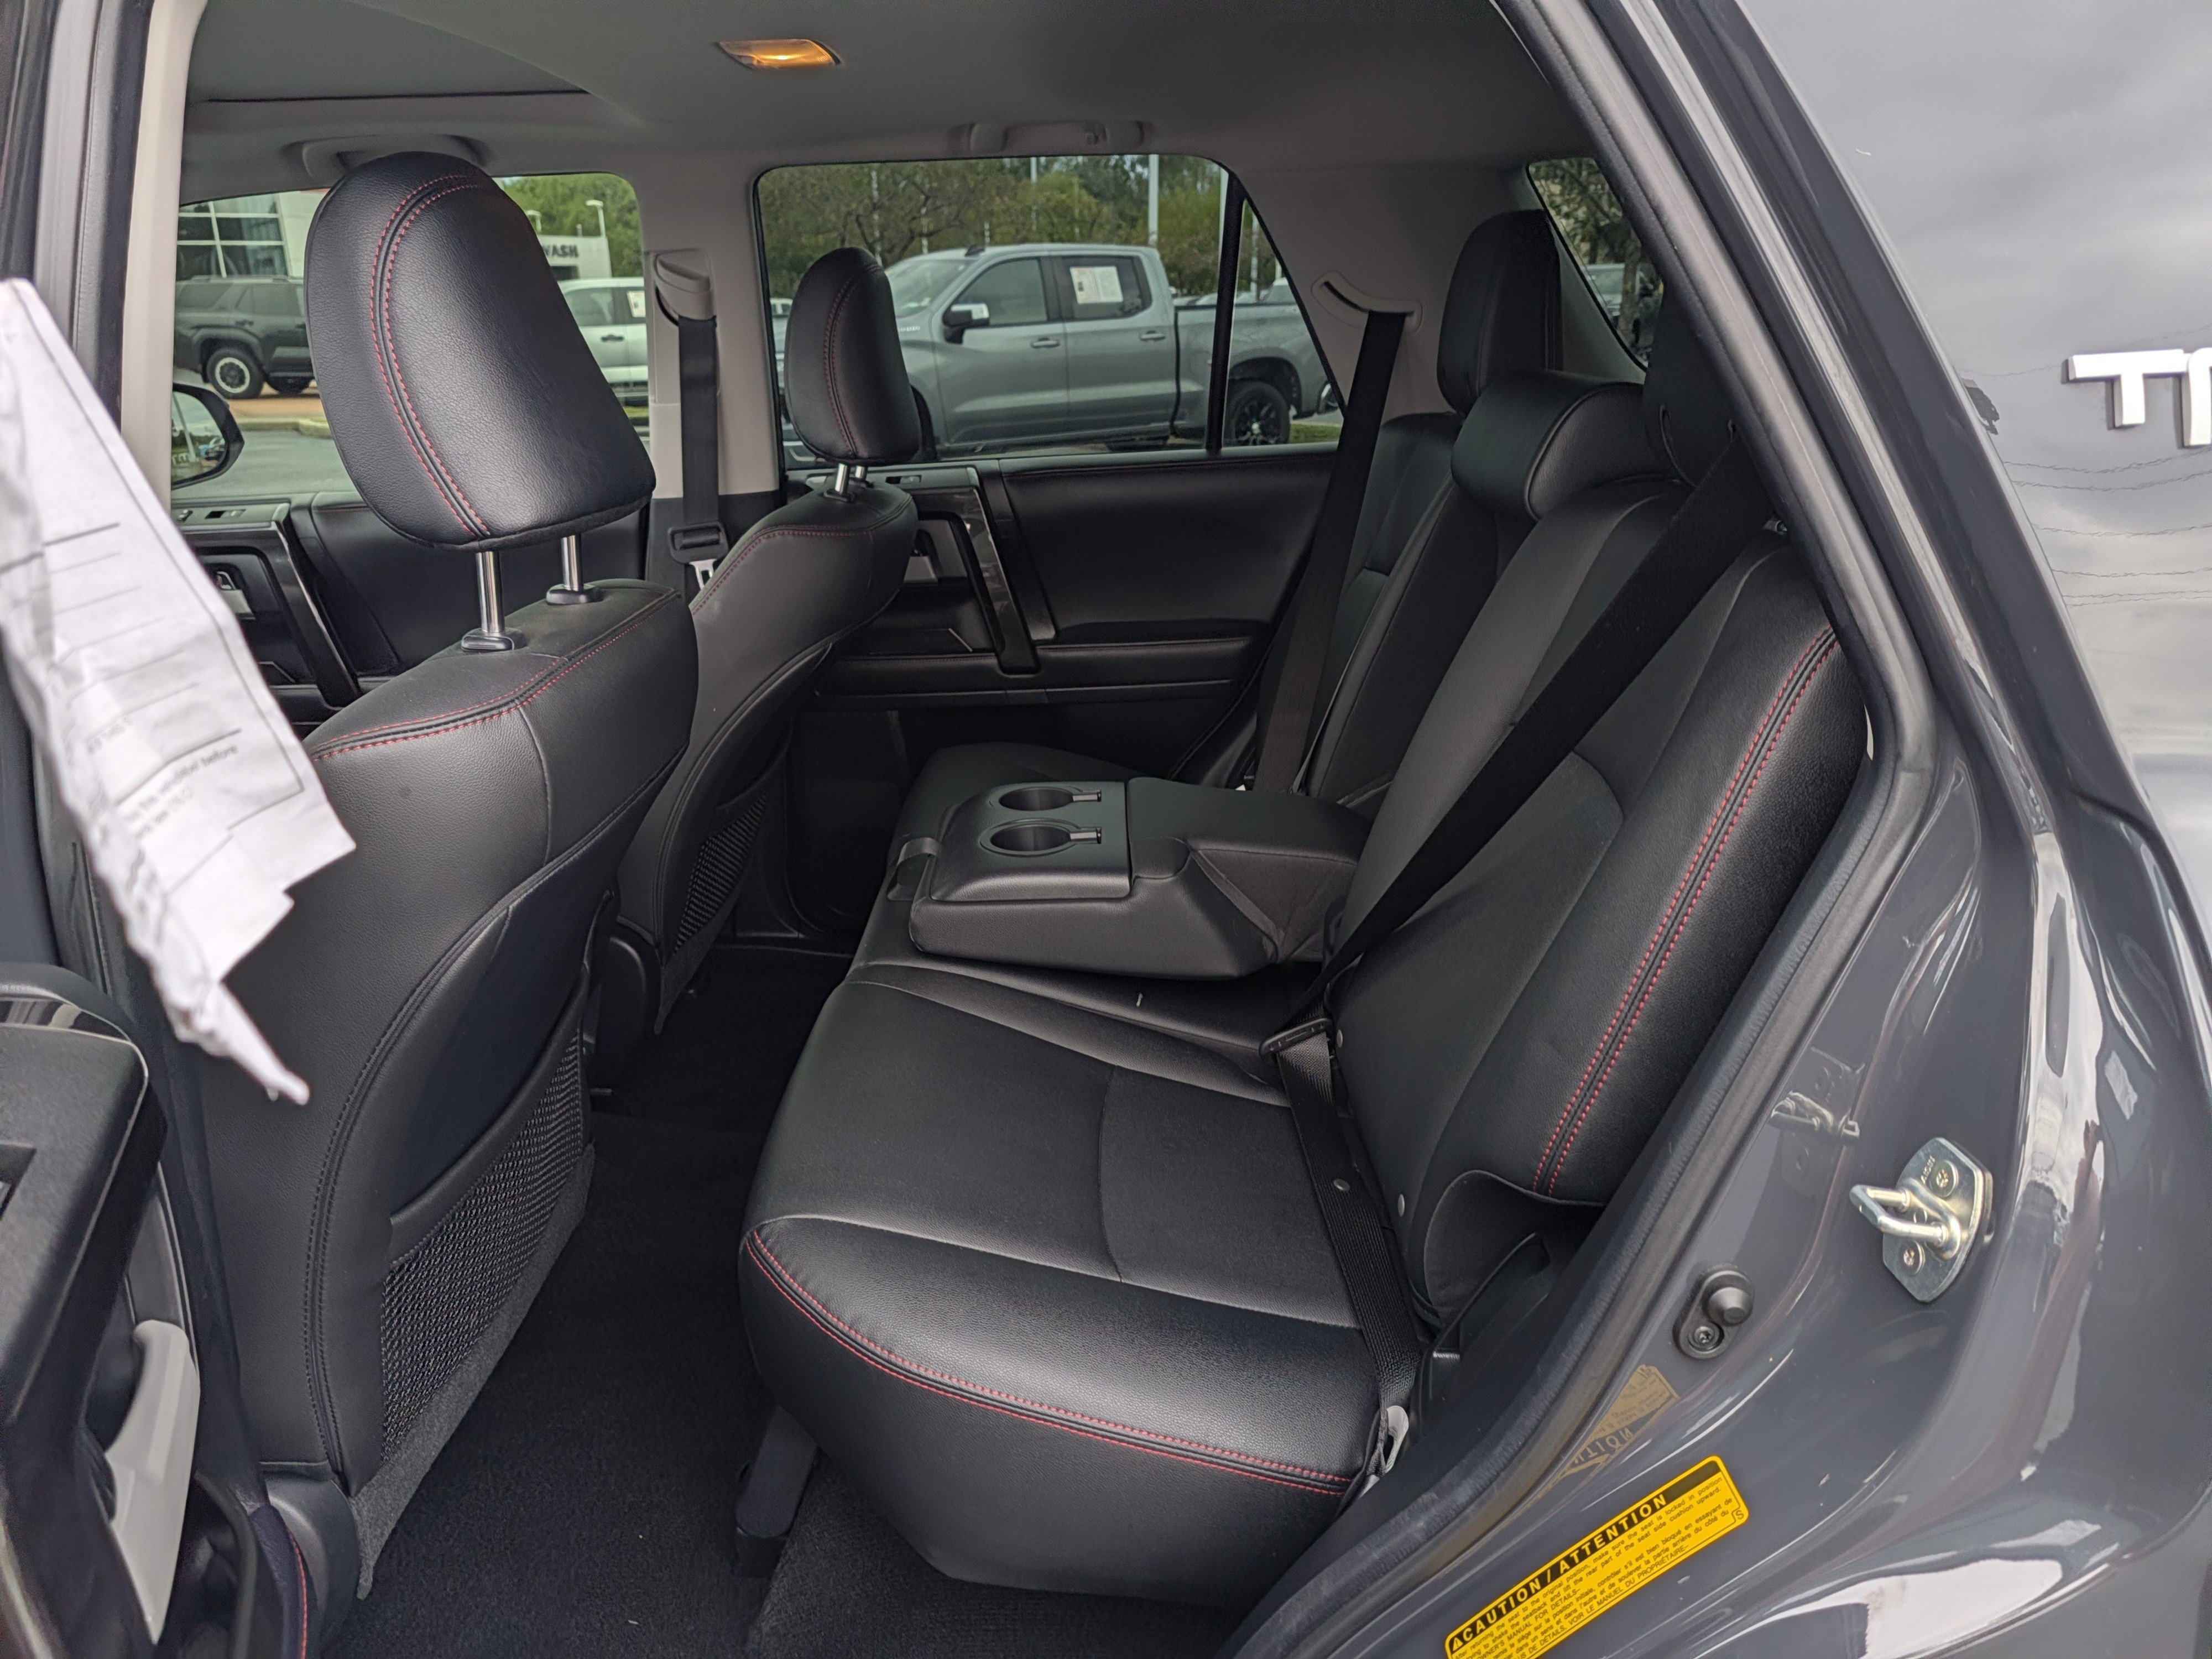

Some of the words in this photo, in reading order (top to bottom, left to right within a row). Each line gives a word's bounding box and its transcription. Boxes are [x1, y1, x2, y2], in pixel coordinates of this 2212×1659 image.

[1462, 1578, 1542, 1642] CAUTION
[1559, 1494, 1667, 1574] ATTENTION
[1470, 1631, 1494, 1651] returning
[1495, 1623, 1505, 1631] the
[1507, 1611, 1520, 1623] seat
[1530, 1598, 1540, 1606] the
[1542, 1580, 1563, 1598] original
[1593, 1550, 1609, 1563] make
[1611, 1540, 1625, 1551] sure
[1627, 1531, 1637, 1540] the
[1640, 1520, 1654, 1532] seat
[1665, 1499, 1686, 1515] locked
[1697, 1477, 1722, 1496] position
[1491, 1629, 1508, 1644] shake
[1510, 1621, 1520, 1630] the
[1522, 1601, 1547, 1621] seatback
[1550, 1591, 1561, 1603] and
[1573, 1577, 1583, 1585] the
[1585, 1566, 1598, 1577] rear
[1600, 1556, 1613, 1568] part
[1615, 1549, 1622, 1557] of
[1624, 1542, 1635, 1551] the
[1637, 1531, 1651, 1543] seat
[1653, 1521, 1667, 1532] side
[1670, 1504, 1694, 1522] cushion
[1533, 1623, 1542, 1632] sur
[1552, 1601, 1573, 1620] position
[1635, 1553, 1645, 1562] est
[1646, 1544, 1660, 1555] bien
[1661, 1529, 1682, 1545] bloqué
[1695, 1504, 1722, 1524] essayant
[1735, 1509, 1745, 1520] S
[1507, 1621, 1532, 1641] MANUAL
[1535, 1609, 1548, 1622] FOR
[1515, 1642, 1529, 1654] dans
[1564, 1608, 1578, 1620] dans
[1618, 1564, 1642, 1583] soulever
[1652, 1547, 1670, 1561] partie
[1672, 1533, 1692, 1548] arrière
[1694, 1526, 1703, 1534] du
[1704, 1515, 1718, 1527] côté
[1528, 1644, 1538, 1654] DE
[1568, 1611, 1584, 1625] VOIR
[1585, 1604, 1595, 1614] LE
[1597, 1587, 1623, 1606] MANUEL
[1625, 1577, 1635, 1588] DU
